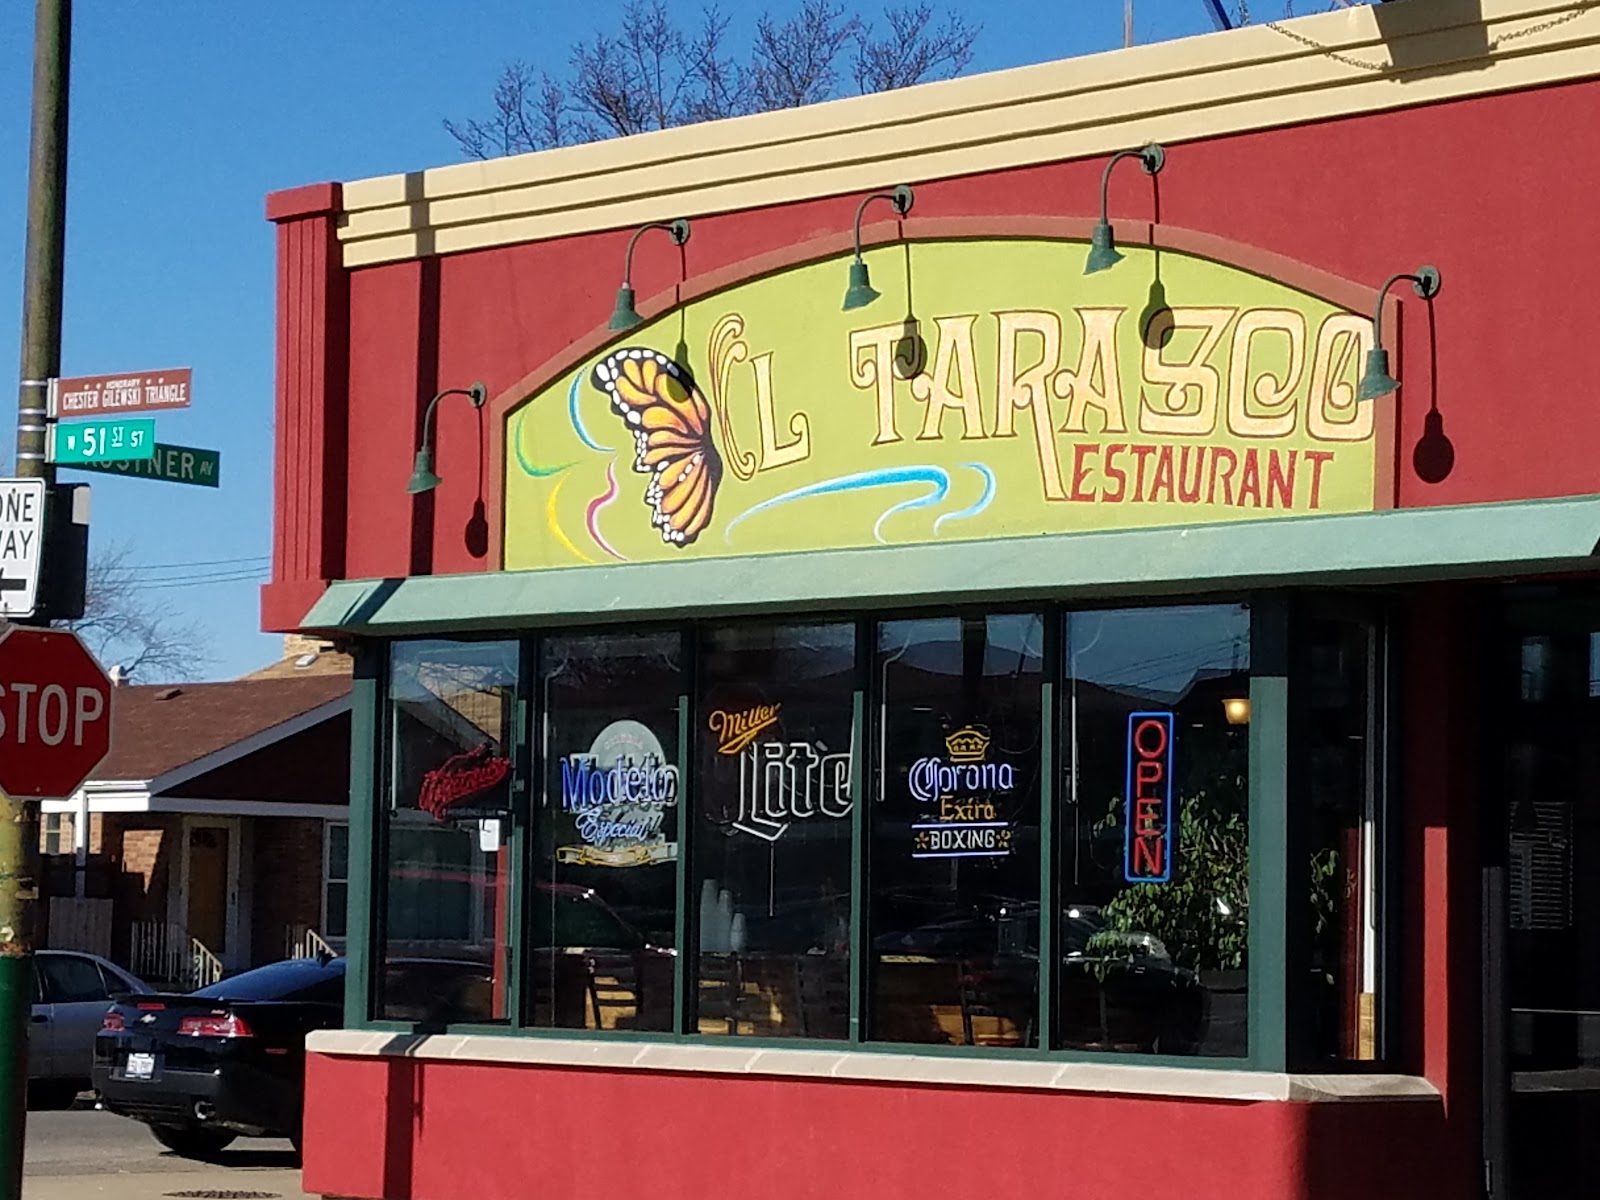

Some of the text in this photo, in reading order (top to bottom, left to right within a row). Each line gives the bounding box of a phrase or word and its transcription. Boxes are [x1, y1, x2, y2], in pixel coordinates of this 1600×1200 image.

[62, 382, 187, 411] CHESTER GILEWSKI TRIANGLE
[105, 378, 141, 389] HONORARY
[67, 435, 76, 450] W
[130, 430, 145, 448] ST
[199, 460, 214, 476] AV
[0, 493, 35, 522] NE
[0, 530, 34, 560] AY
[0, 682, 103, 746] TOP
[708, 703, 782, 755] Miller
[560, 752, 669, 812] Modelo
[732, 740, 852, 842] Lite
[908, 757, 1014, 801] Corona
[939, 796, 996, 821] Extra
[1133, 719, 1167, 876] OPEN
[930, 829, 995, 850] BOXING
